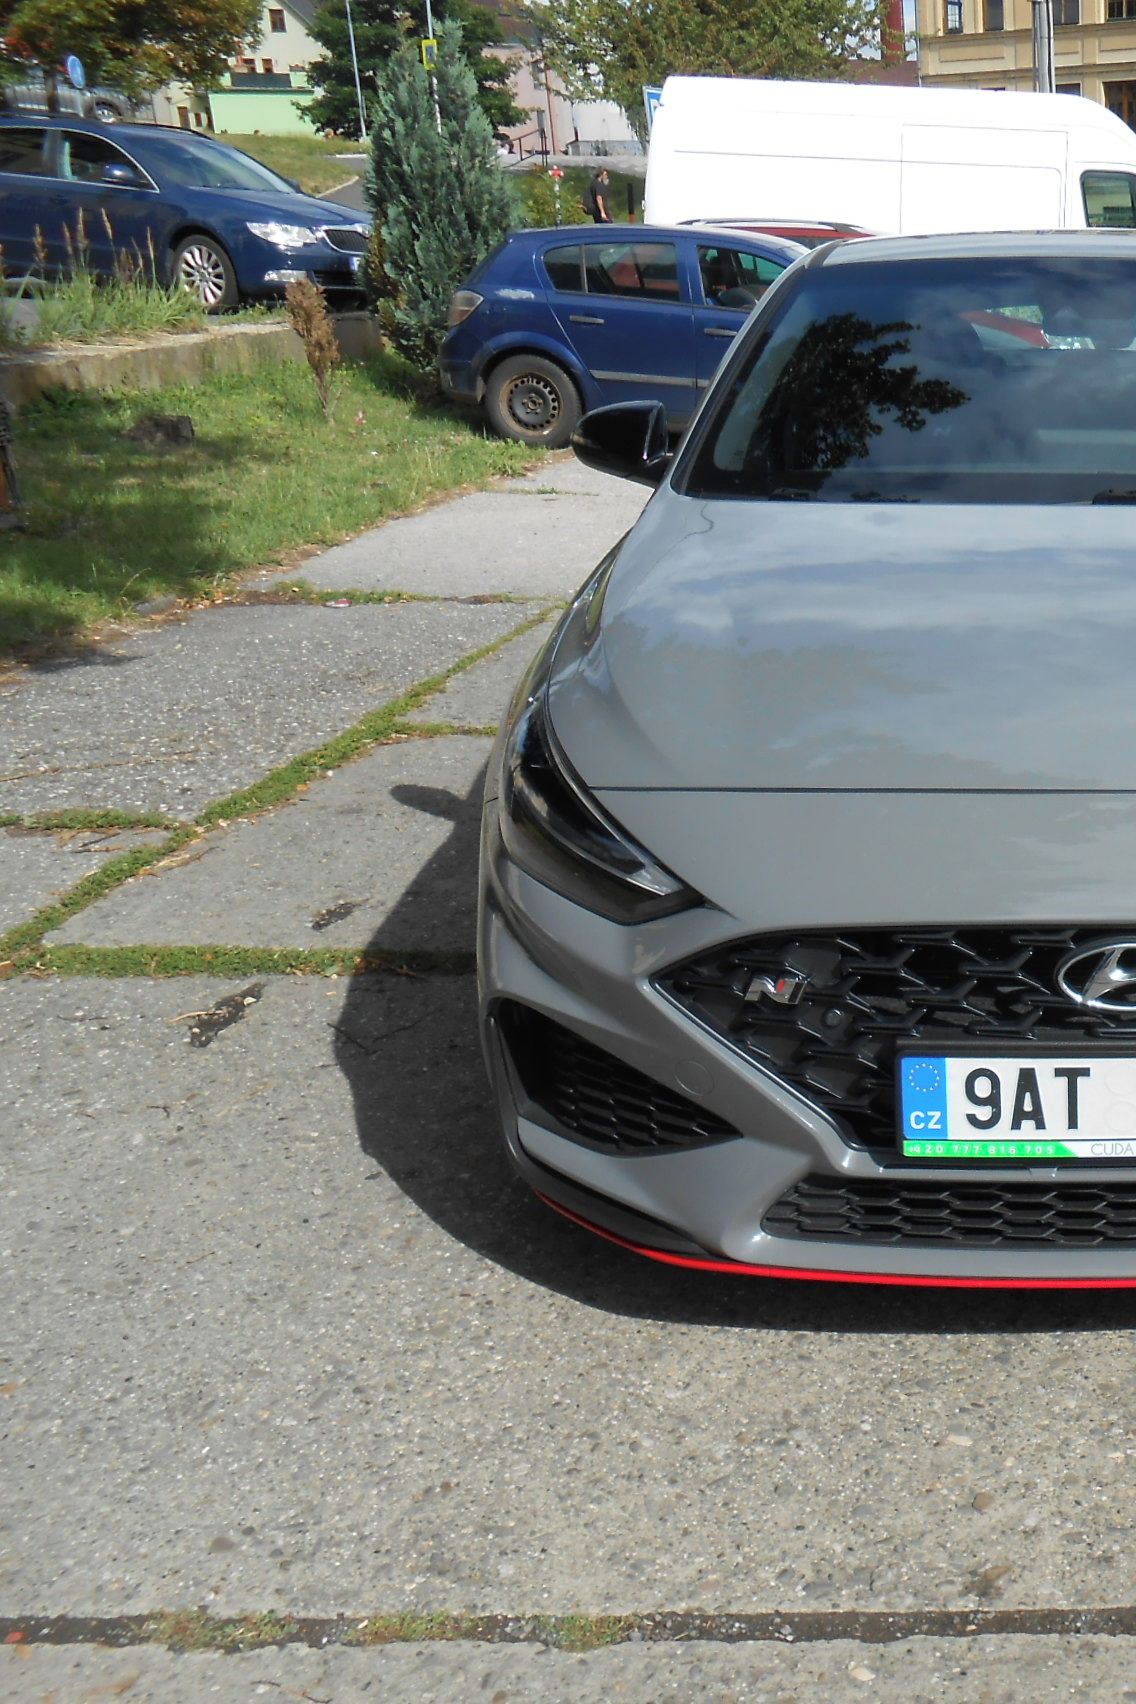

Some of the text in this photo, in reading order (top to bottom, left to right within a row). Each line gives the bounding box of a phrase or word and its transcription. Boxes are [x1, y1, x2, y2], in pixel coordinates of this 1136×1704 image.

[744, 977, 807, 1005] N
[964, 1067, 1091, 1130] 9AT
[909, 1110, 942, 1130] CZ
[908, 1143, 944, 1154] +420
[952, 1143, 980, 1154] 777
[987, 1143, 1017, 1154] 816
[1090, 1142, 1135, 1156] CUDA
